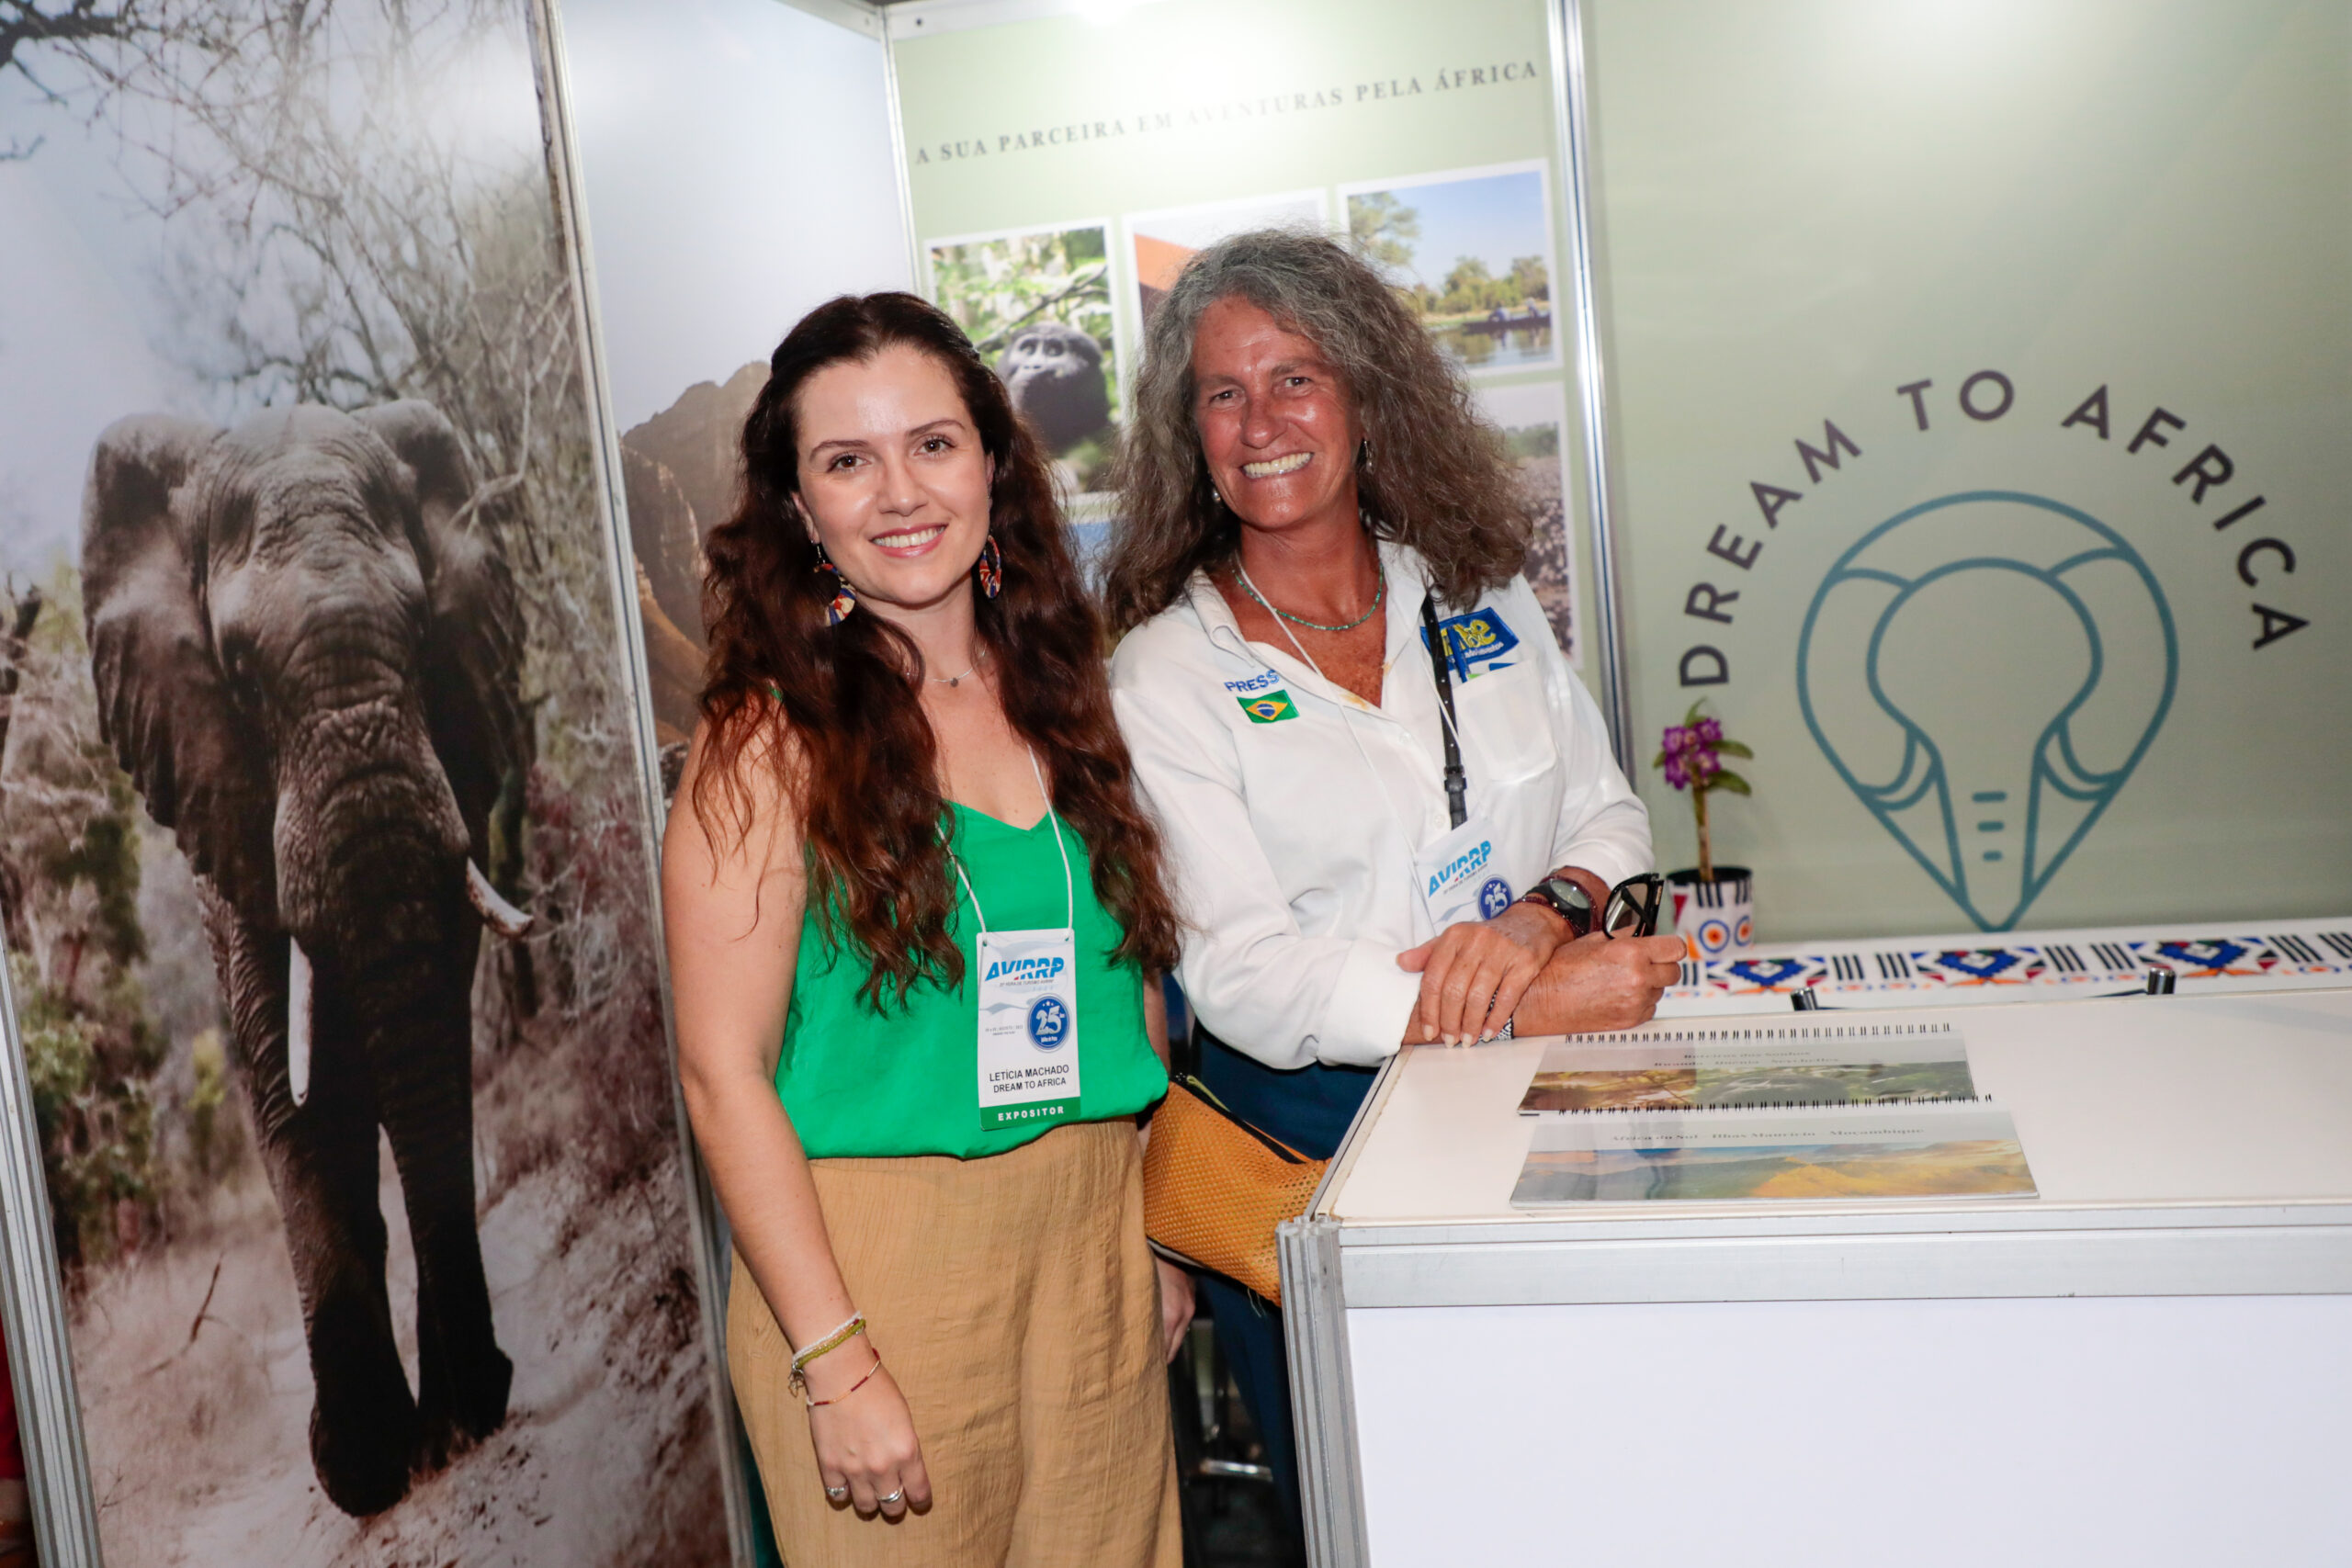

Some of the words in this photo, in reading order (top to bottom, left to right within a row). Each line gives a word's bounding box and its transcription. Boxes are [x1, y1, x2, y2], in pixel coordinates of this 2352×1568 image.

[915, 148, 931, 164] A
[940, 139, 988, 162] SUA
[998, 118, 1125, 153] PARCEIRA
[1136, 110, 1173, 132] EM
[1184, 86, 1344, 129] AVENTURAS
[1355, 75, 1424, 103] PELA
[1433, 60, 1539, 92] ÁFRICA
[1678, 417, 1863, 689] DREAM
[1895, 368, 2016, 433] TO
[2059, 383, 2312, 651] AFRICA
[1223, 669, 1280, 693] PRESS
[1428, 840, 1492, 898] AVIRRP
[1485, 882, 1508, 919] 25
[984, 956, 1065, 982] AVIRRP
[1035, 1005, 1062, 1036] 25
[1024, 1064, 1069, 1077] MACHADO
[993, 1082, 1023, 1093] DREAM
[1024, 1080, 1035, 1089] TO
[1037, 1077, 1067, 1088] AFRICA
[997, 1105, 1065, 1122] EXPOSITOR
